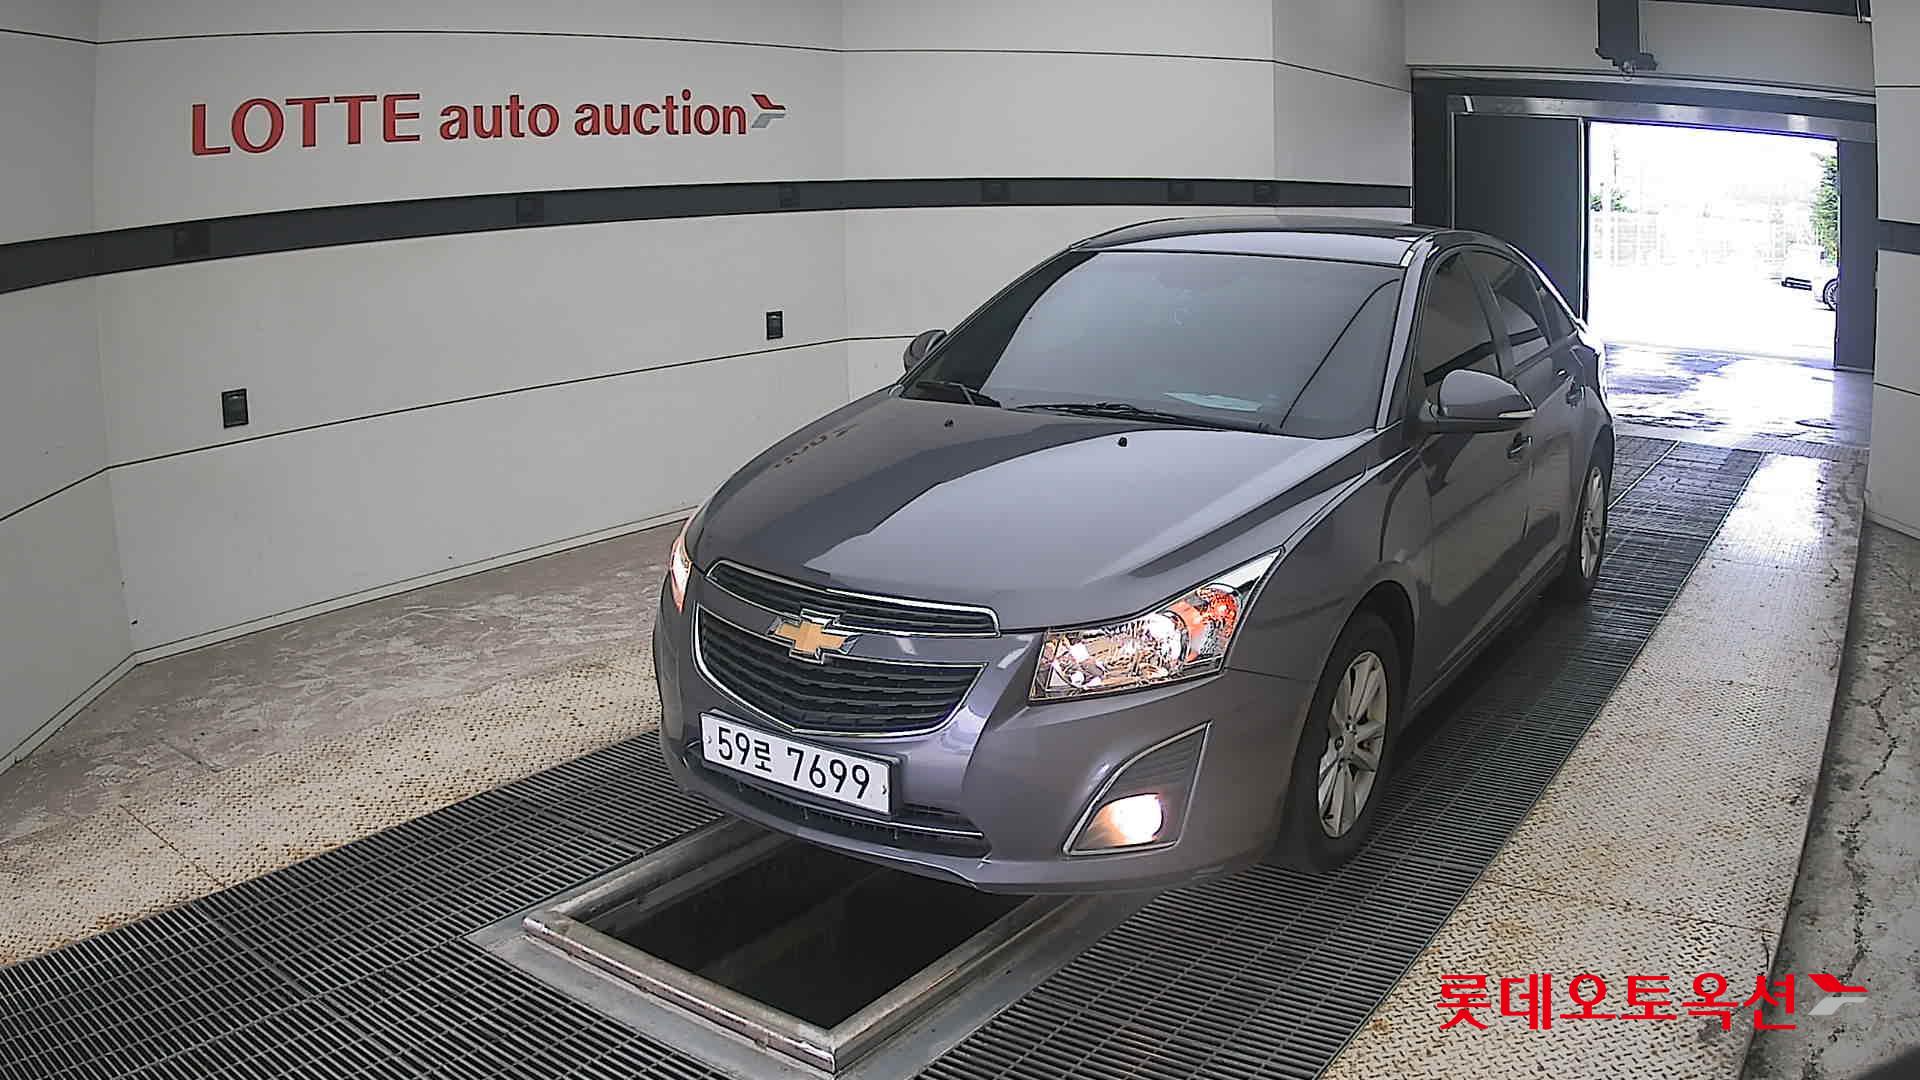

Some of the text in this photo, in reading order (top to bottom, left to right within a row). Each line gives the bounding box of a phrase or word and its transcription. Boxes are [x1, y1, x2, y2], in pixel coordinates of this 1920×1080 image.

[191, 88, 748, 157] LOTTE auto auction
[718, 726, 870, 800] 59로 7699
